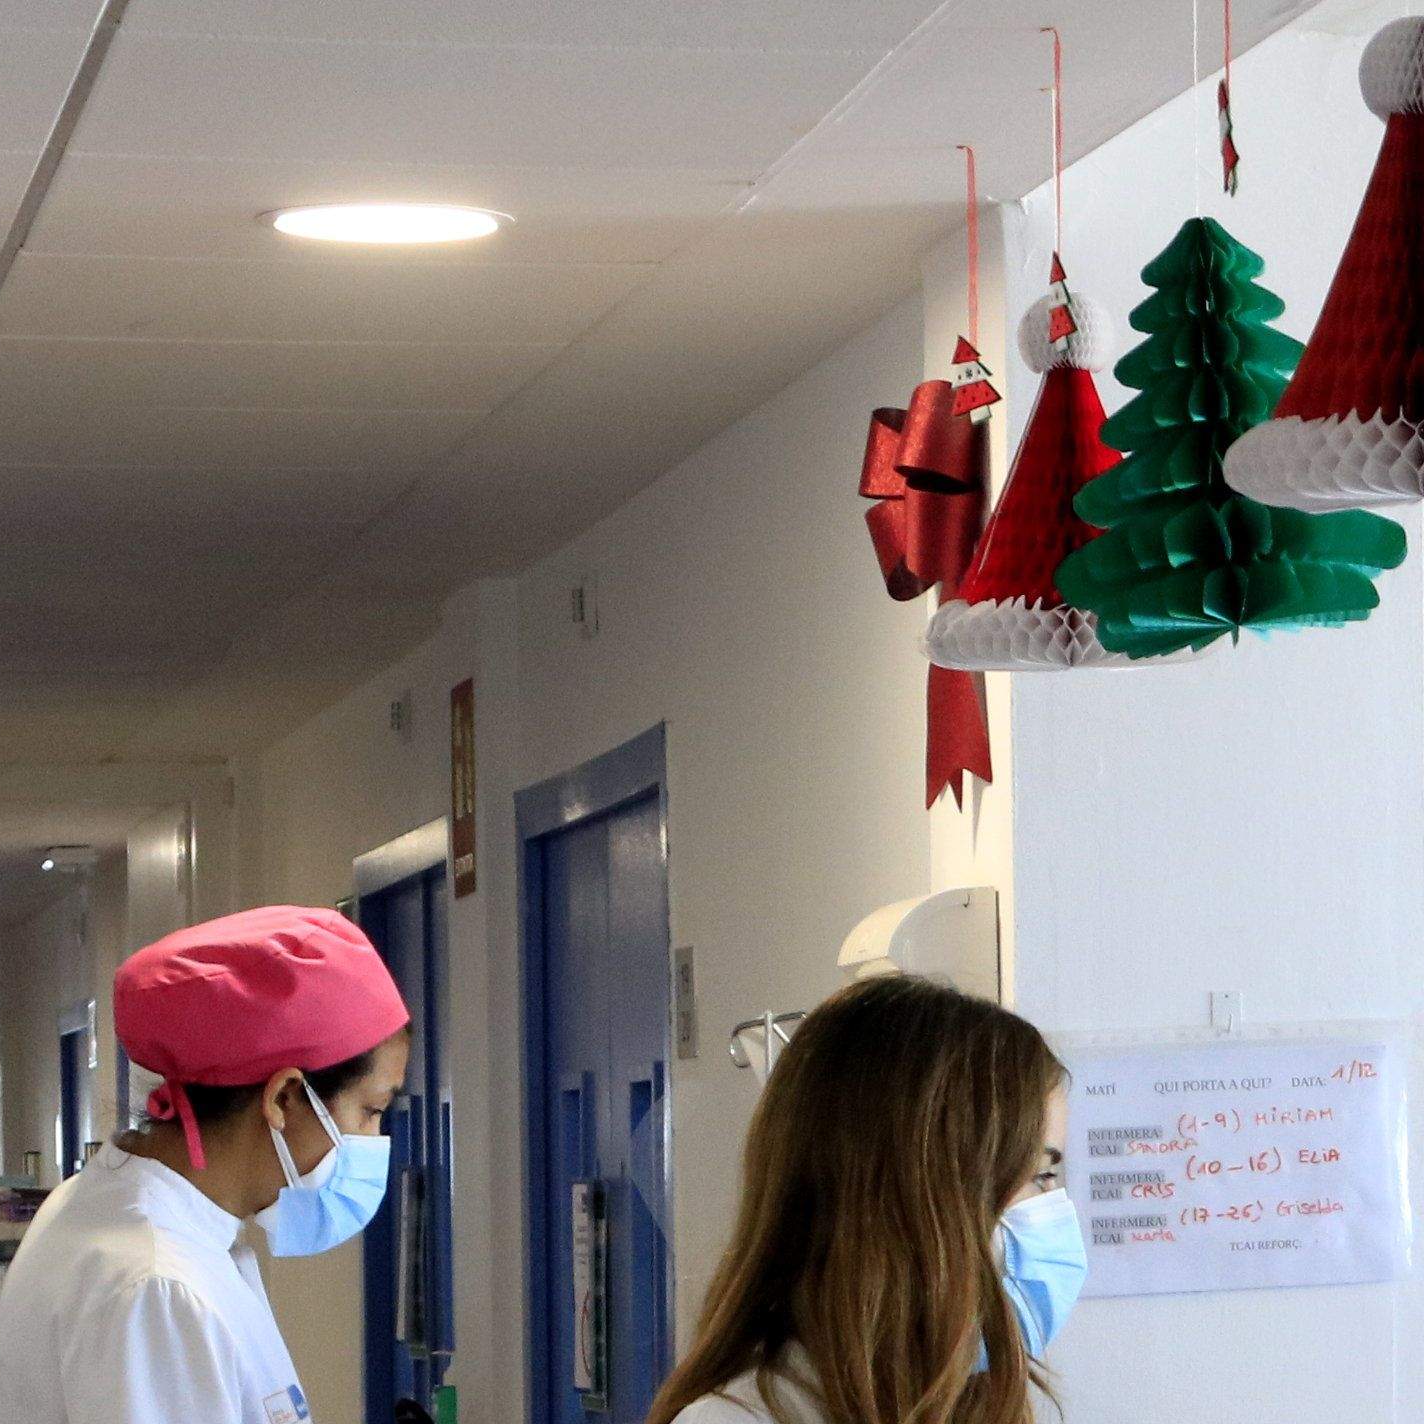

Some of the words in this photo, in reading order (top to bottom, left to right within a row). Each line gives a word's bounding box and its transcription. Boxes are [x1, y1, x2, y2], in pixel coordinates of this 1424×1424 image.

[1085, 1083, 1116, 1097] MATÍ
[1154, 1081, 1179, 1094] QUI
[1183, 1079, 1226, 1092] PORTA
[1228, 1079, 1238, 1090] A
[1240, 1077, 1272, 1092] QUI?
[1291, 1076, 1327, 1088] DATA:
[1230, 1242, 1256, 1251] TCAI
